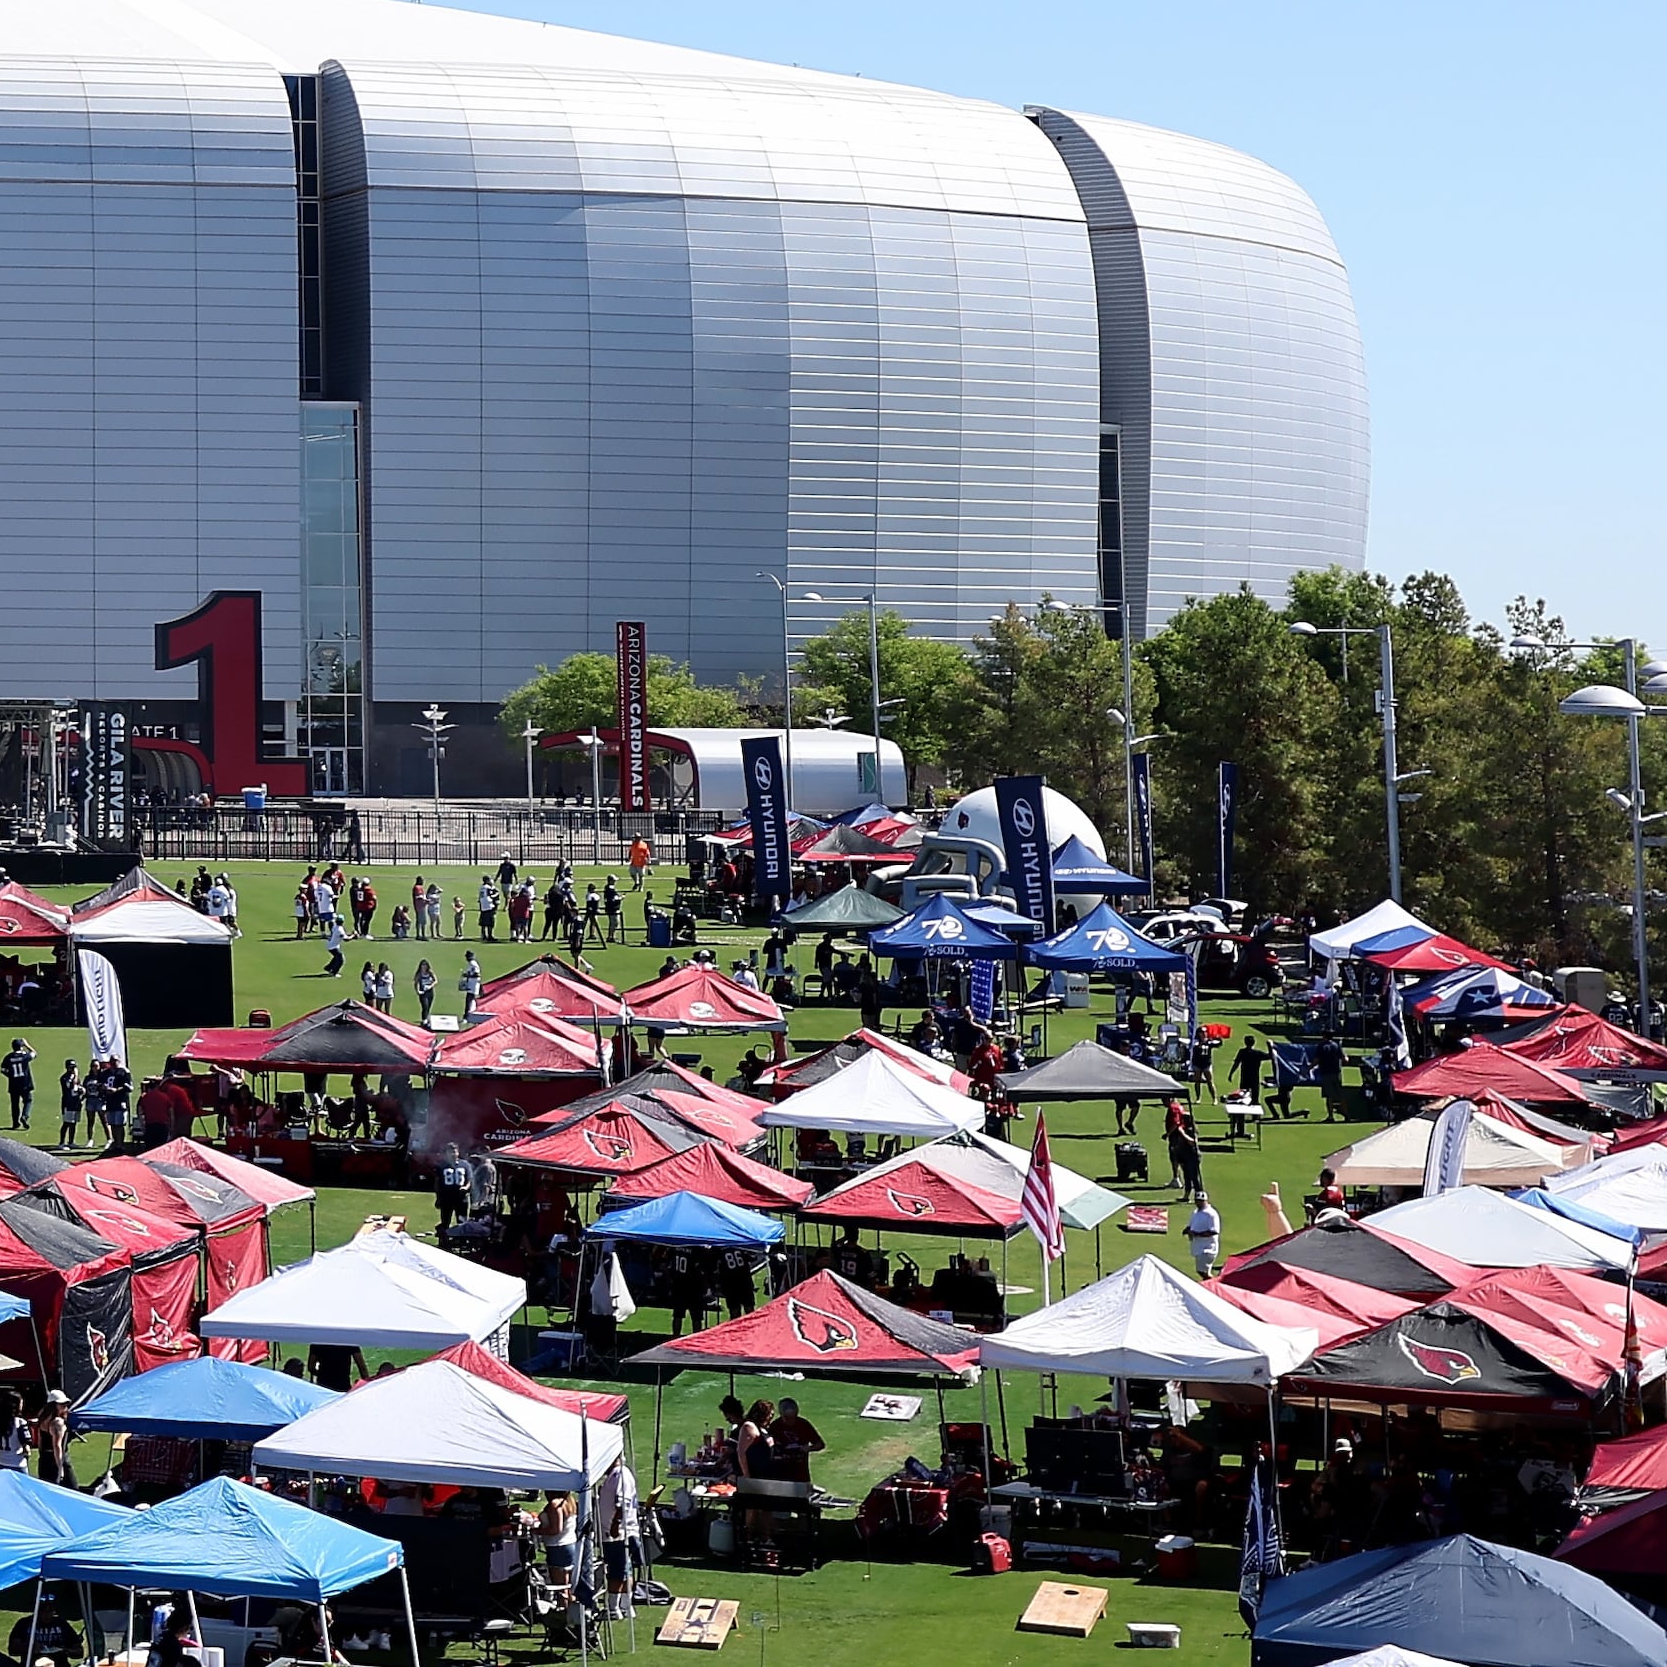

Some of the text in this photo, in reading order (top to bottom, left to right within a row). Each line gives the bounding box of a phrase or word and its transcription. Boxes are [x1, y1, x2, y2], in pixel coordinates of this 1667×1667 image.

[155, 590, 313, 796] 1
[627, 625, 644, 807] ARIZONA CARDINALS
[131, 725, 165, 738] ATE
[108, 713, 125, 838] GILA RIVER
[761, 794, 779, 879] HYUNDAI
[12, 1063, 24, 1077] 11
[675, 1256, 688, 1274] 10
[725, 1250, 745, 1270] 86
[840, 1259, 857, 1276] 19
